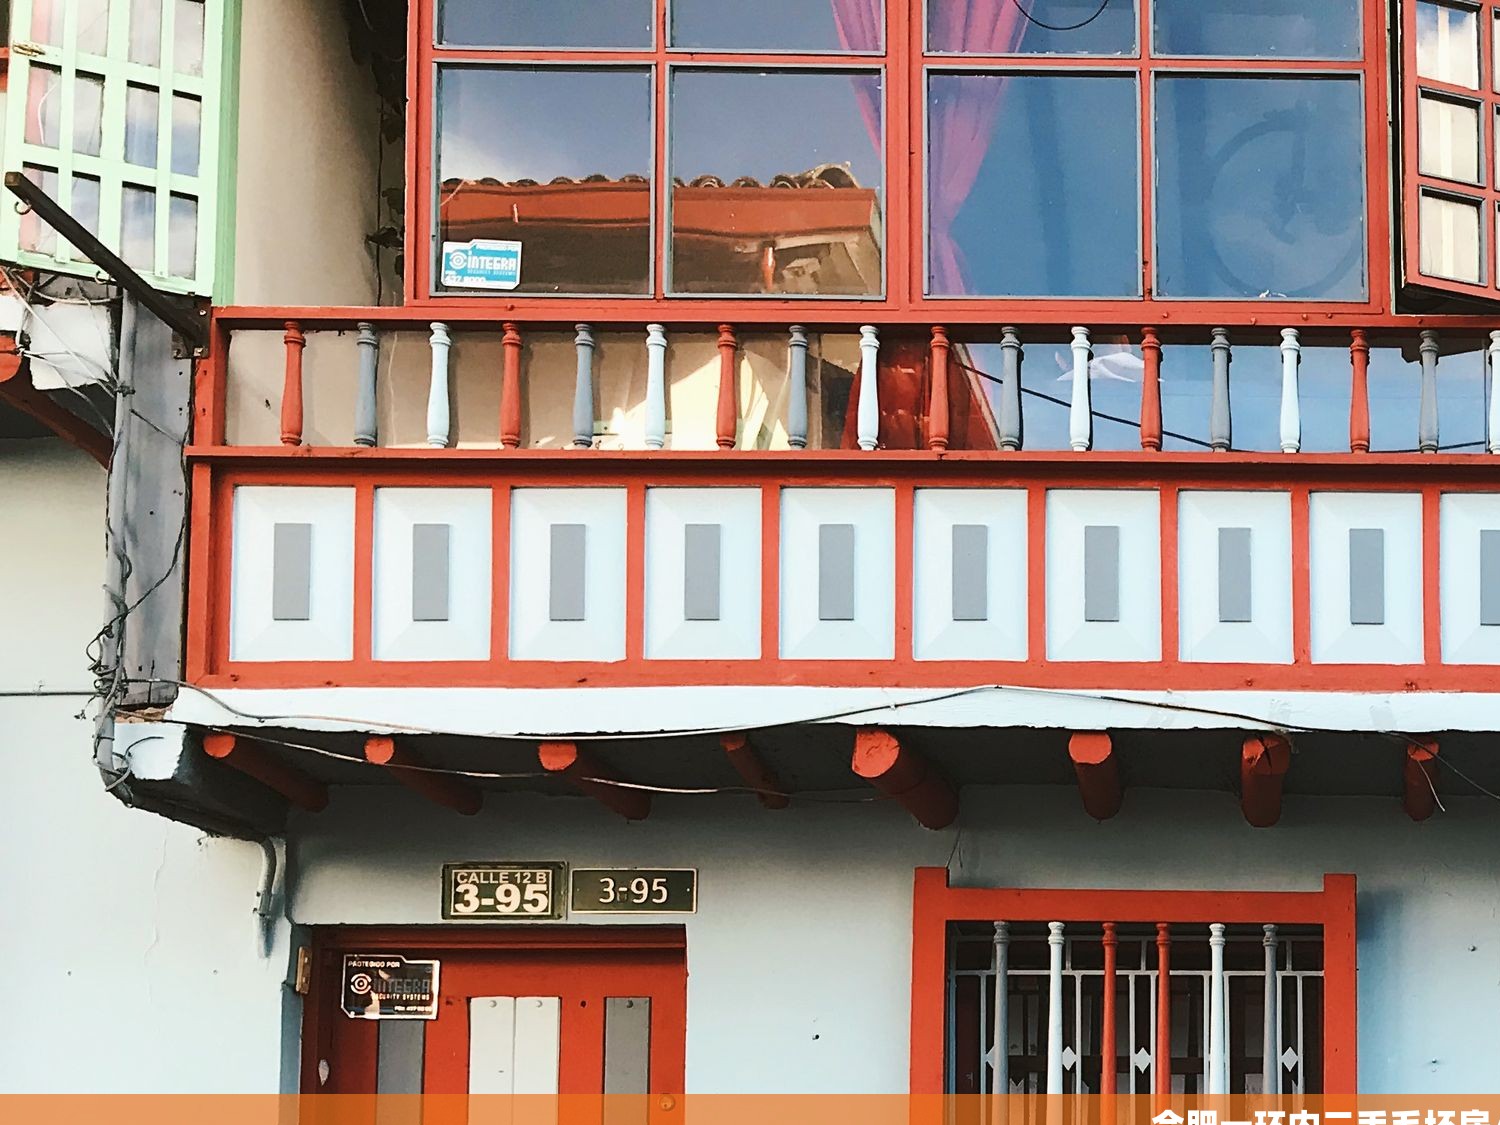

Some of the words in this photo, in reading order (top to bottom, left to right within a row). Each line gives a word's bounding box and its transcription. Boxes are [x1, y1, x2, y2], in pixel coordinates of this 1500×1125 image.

[456, 872, 509, 884] CALLE
[514, 872, 531, 884] 12
[536, 872, 547, 884] B
[599, 877, 668, 904] 3-95
[454, 883, 549, 914] 3-95
